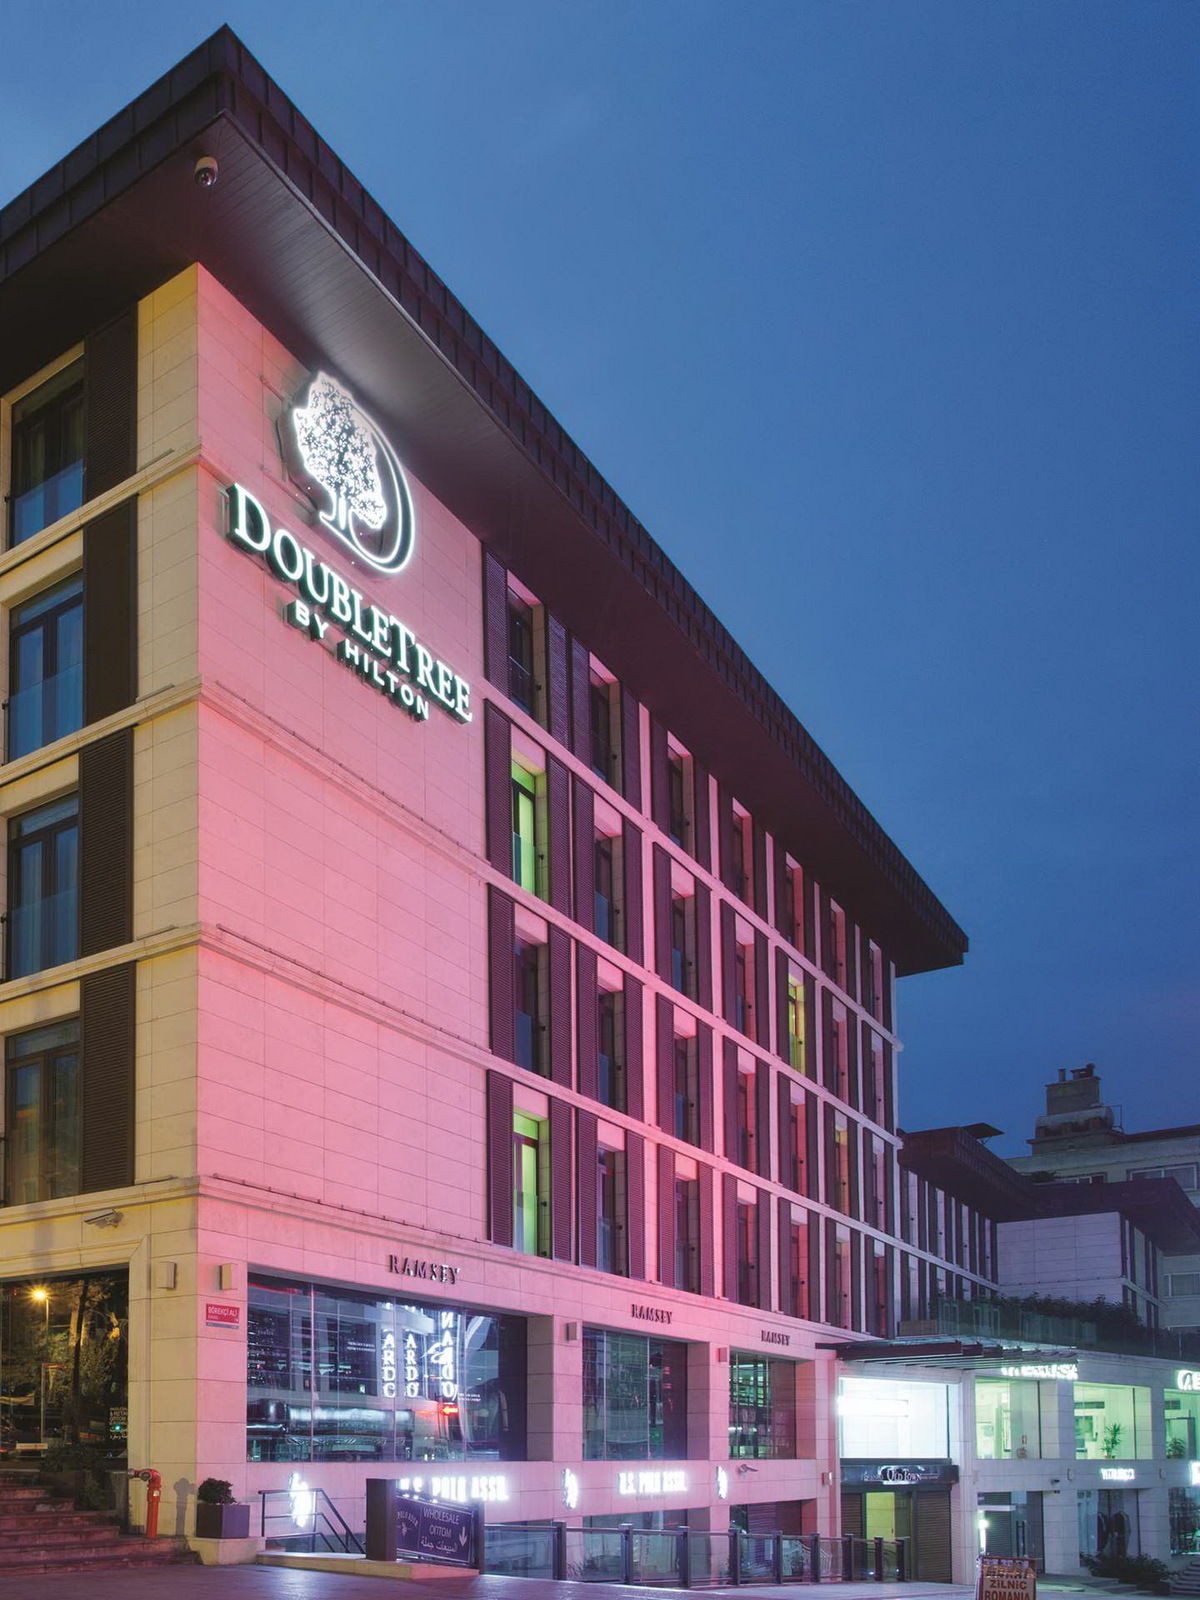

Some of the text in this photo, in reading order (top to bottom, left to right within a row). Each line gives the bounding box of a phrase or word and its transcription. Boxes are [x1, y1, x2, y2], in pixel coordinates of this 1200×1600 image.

[227, 482, 473, 724] DOUBLETREE
[289, 598, 432, 722] BY HILTON
[388, 1254, 461, 1285] RAMSEY
[631, 1303, 673, 1325] RAMSEY
[760, 1329, 791, 1347] RAMSEY
[423, 1507, 460, 1525] WHOLESALE
